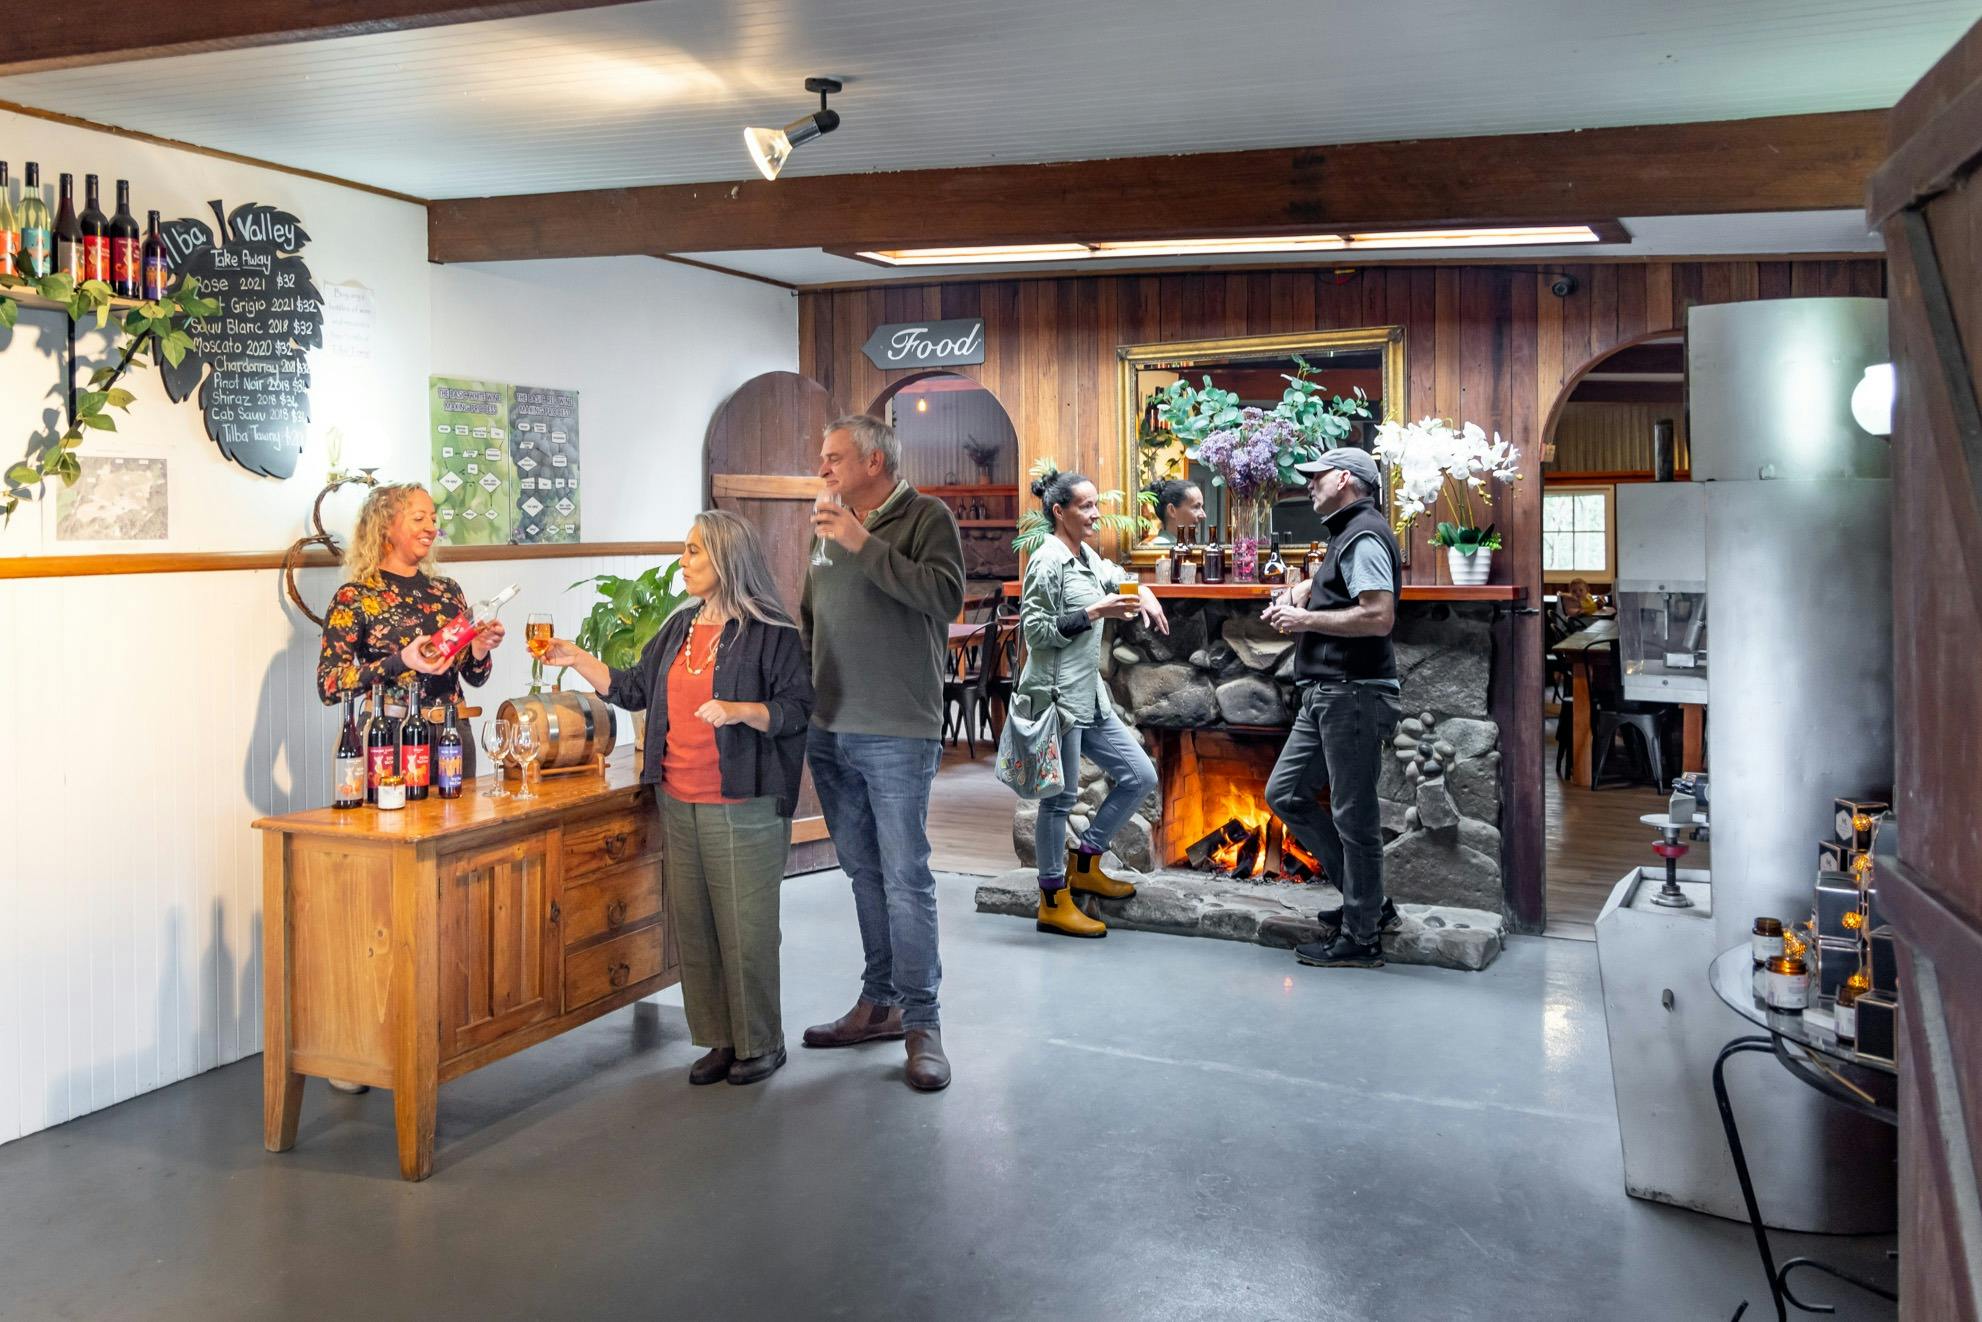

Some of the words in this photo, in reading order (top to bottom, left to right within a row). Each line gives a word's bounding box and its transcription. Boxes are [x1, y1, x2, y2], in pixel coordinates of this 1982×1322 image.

[236, 213, 295, 250] Valley
[211, 250, 239, 267] Take
[242, 250, 271, 275] Away
[240, 278, 266, 290] 2021
[276, 272, 295, 289] $32
[231, 297, 266, 317] Grigio
[271, 298, 294, 312] 2021
[296, 296, 318, 312] $32
[226, 319, 264, 334] Blanc
[268, 320, 288, 333] 2018
[293, 319, 313, 335] $32
[193, 337, 242, 357] Moscato
[246, 340, 272, 355] 2020
[274, 339, 293, 356] $32
[887, 323, 981, 360] Food
[214, 355, 280, 382] Chardonnay
[213, 372, 240, 390] Pinot
[243, 376, 264, 391] Noir
[266, 377, 290, 391] 2018
[212, 389, 252, 407] Shiraz
[256, 394, 277, 406] 2018
[211, 407, 235, 420] Cab
[238, 406, 266, 420] Sauv
[269, 408, 289, 420] 2018
[222, 423, 249, 442] Tilba
[250, 424, 282, 451] Tawny
